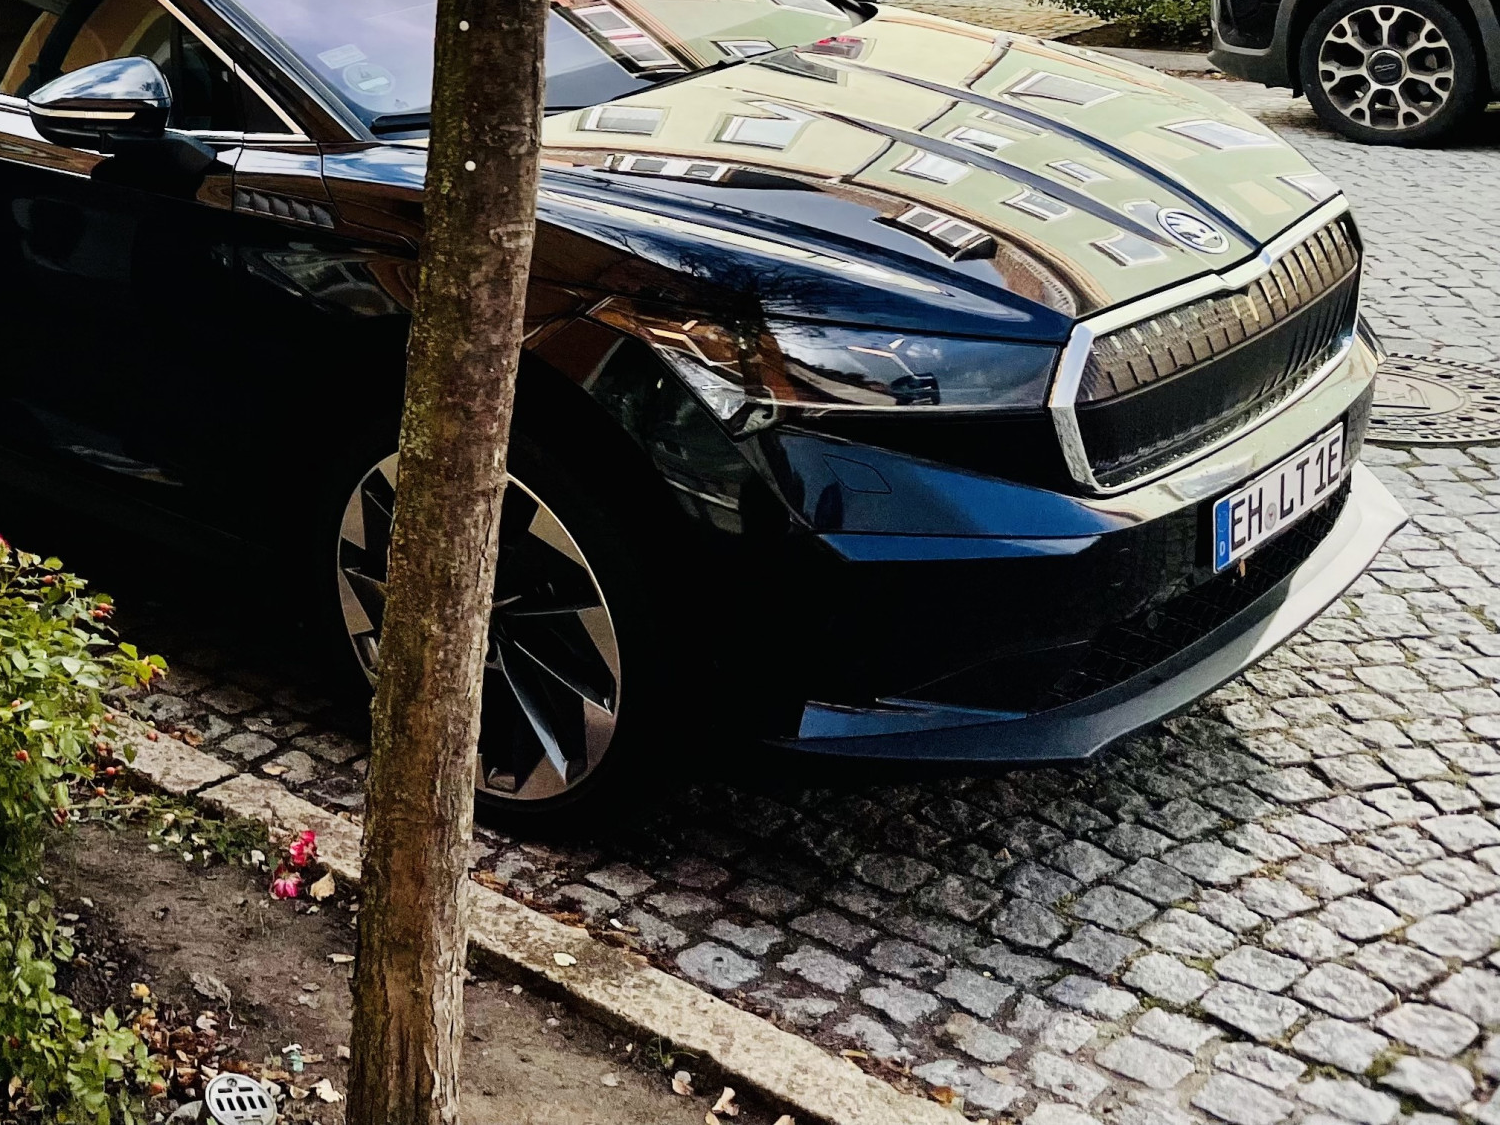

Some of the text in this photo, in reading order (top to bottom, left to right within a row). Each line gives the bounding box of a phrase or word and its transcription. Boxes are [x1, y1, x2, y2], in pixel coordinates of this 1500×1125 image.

[1230, 435, 1341, 552] EH LT 1E
